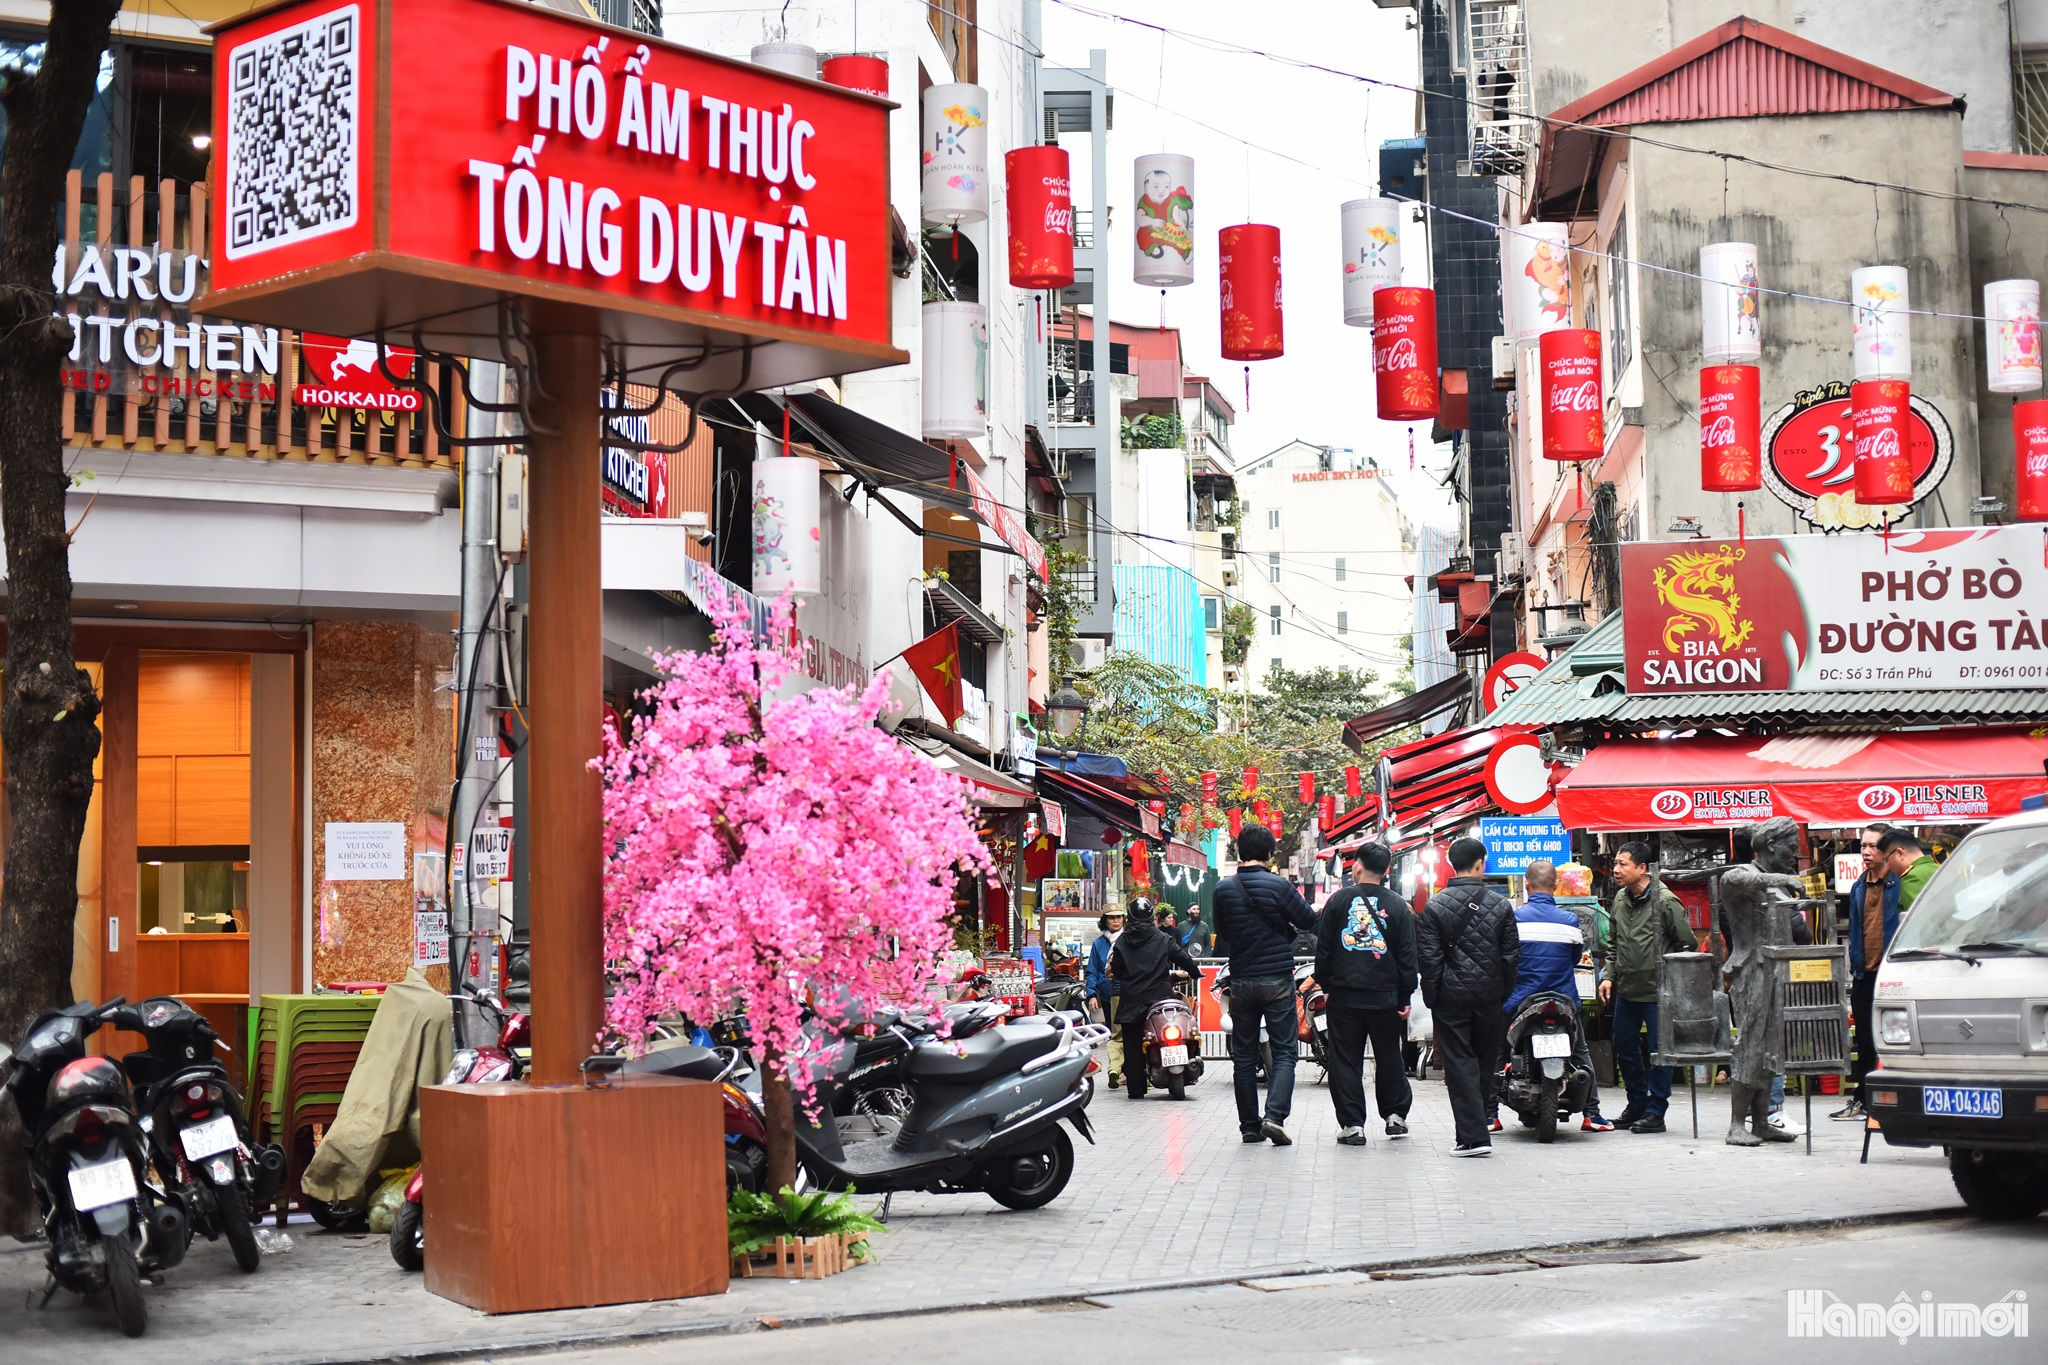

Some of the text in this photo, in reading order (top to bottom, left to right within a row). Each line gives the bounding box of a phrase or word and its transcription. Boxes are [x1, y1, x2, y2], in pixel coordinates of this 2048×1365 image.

[505, 35, 817, 201] PHỐ ẨM THỰC
[468, 134, 848, 320] TỐNG DUY TÂN
[53, 312, 279, 375] ITCHEN
[1548, 356, 1598, 369] CHÚC MỪNG
[1555, 366, 1594, 377] NĂM MỚI
[142, 373, 276, 401] CHICKEN
[1795, 388, 1826, 407] Triple
[1828, 380, 1848, 397] The
[302, 388, 417, 409] HOKKAIDO
[1708, 393, 1735, 403] MỪNG
[1710, 401, 1728, 412] MỚI
[1870, 405, 1898, 415] MỪNG
[1874, 414, 1892, 425] MỚI
[2024, 425, 2047, 436] CHÚC
[1783, 447, 1808, 457] ESTD
[608, 446, 649, 504] KITCHEN
[1292, 468, 1394, 483] HANOI SKY HOTEL
[1861, 558, 2022, 603] PHỞ BÒ
[1818, 612, 1977, 654] ĐƯỜNG
[1683, 640, 1720, 657] BIA
[1643, 657, 1762, 685] SAIGON
[1820, 666, 1932, 681] ĐC: Số 3 Trần Phú
[1959, 666, 1981, 678] ĐT:
[1984, 666, 2015, 678] 0961
[2018, 666, 2043, 678] 001
[475, 736, 497, 748] ROAD
[475, 749, 497, 761] TRAP
[1693, 789, 1772, 806] PILSNER
[1903, 785, 1986, 802] PILSNER
[1693, 807, 1773, 819] EXTRA SMOOTH
[1903, 802, 1989, 815] EXTRA SMOOTH
[1484, 823, 1501, 837] CẤM
[1502, 823, 1518, 836] CÁC
[361, 841, 384, 849] LÒNG
[1491, 839, 1502, 852] TỪ
[1526, 837, 1541, 851] ĐẾN
[338, 851, 367, 860] KHÔNG
[1497, 855, 1518, 868] SÁNG
[1925, 1089, 2000, 1115] 29A-043.46
